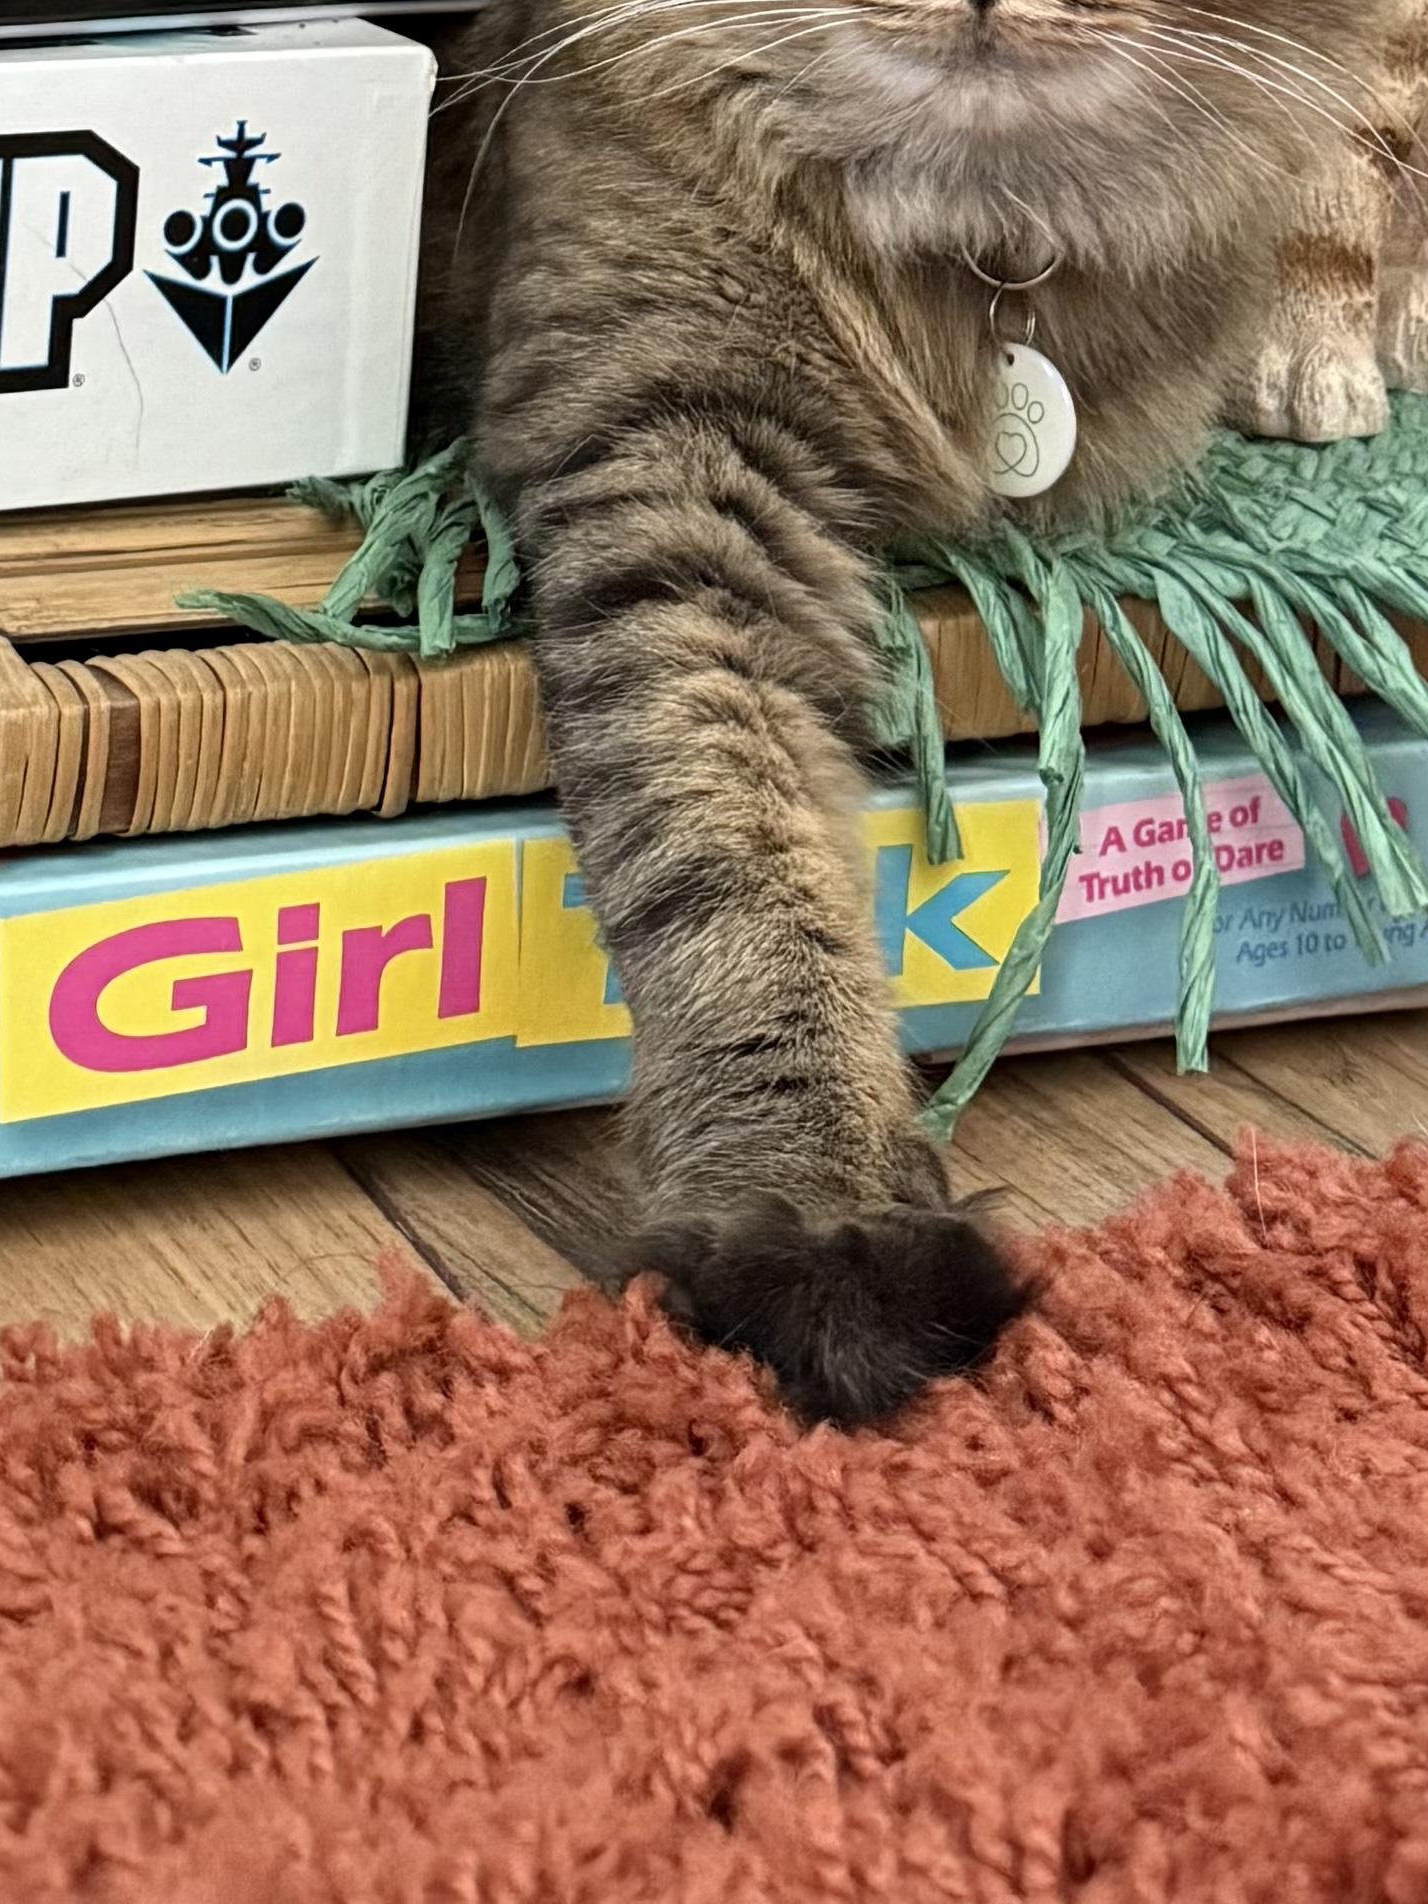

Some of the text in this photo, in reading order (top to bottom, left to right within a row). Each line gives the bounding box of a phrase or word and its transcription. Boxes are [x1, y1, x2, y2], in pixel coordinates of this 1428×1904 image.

[1099, 826, 1127, 857] A
[1229, 796, 1261, 828] of
[1078, 838, 1285, 903] Truth o Dare
[1236, 940, 1288, 967] Ages
[1296, 932, 1319, 955] 10
[1324, 933, 1347, 952] to
[1238, 907, 1285, 934] Any
[47, 875, 488, 1073] Girl
